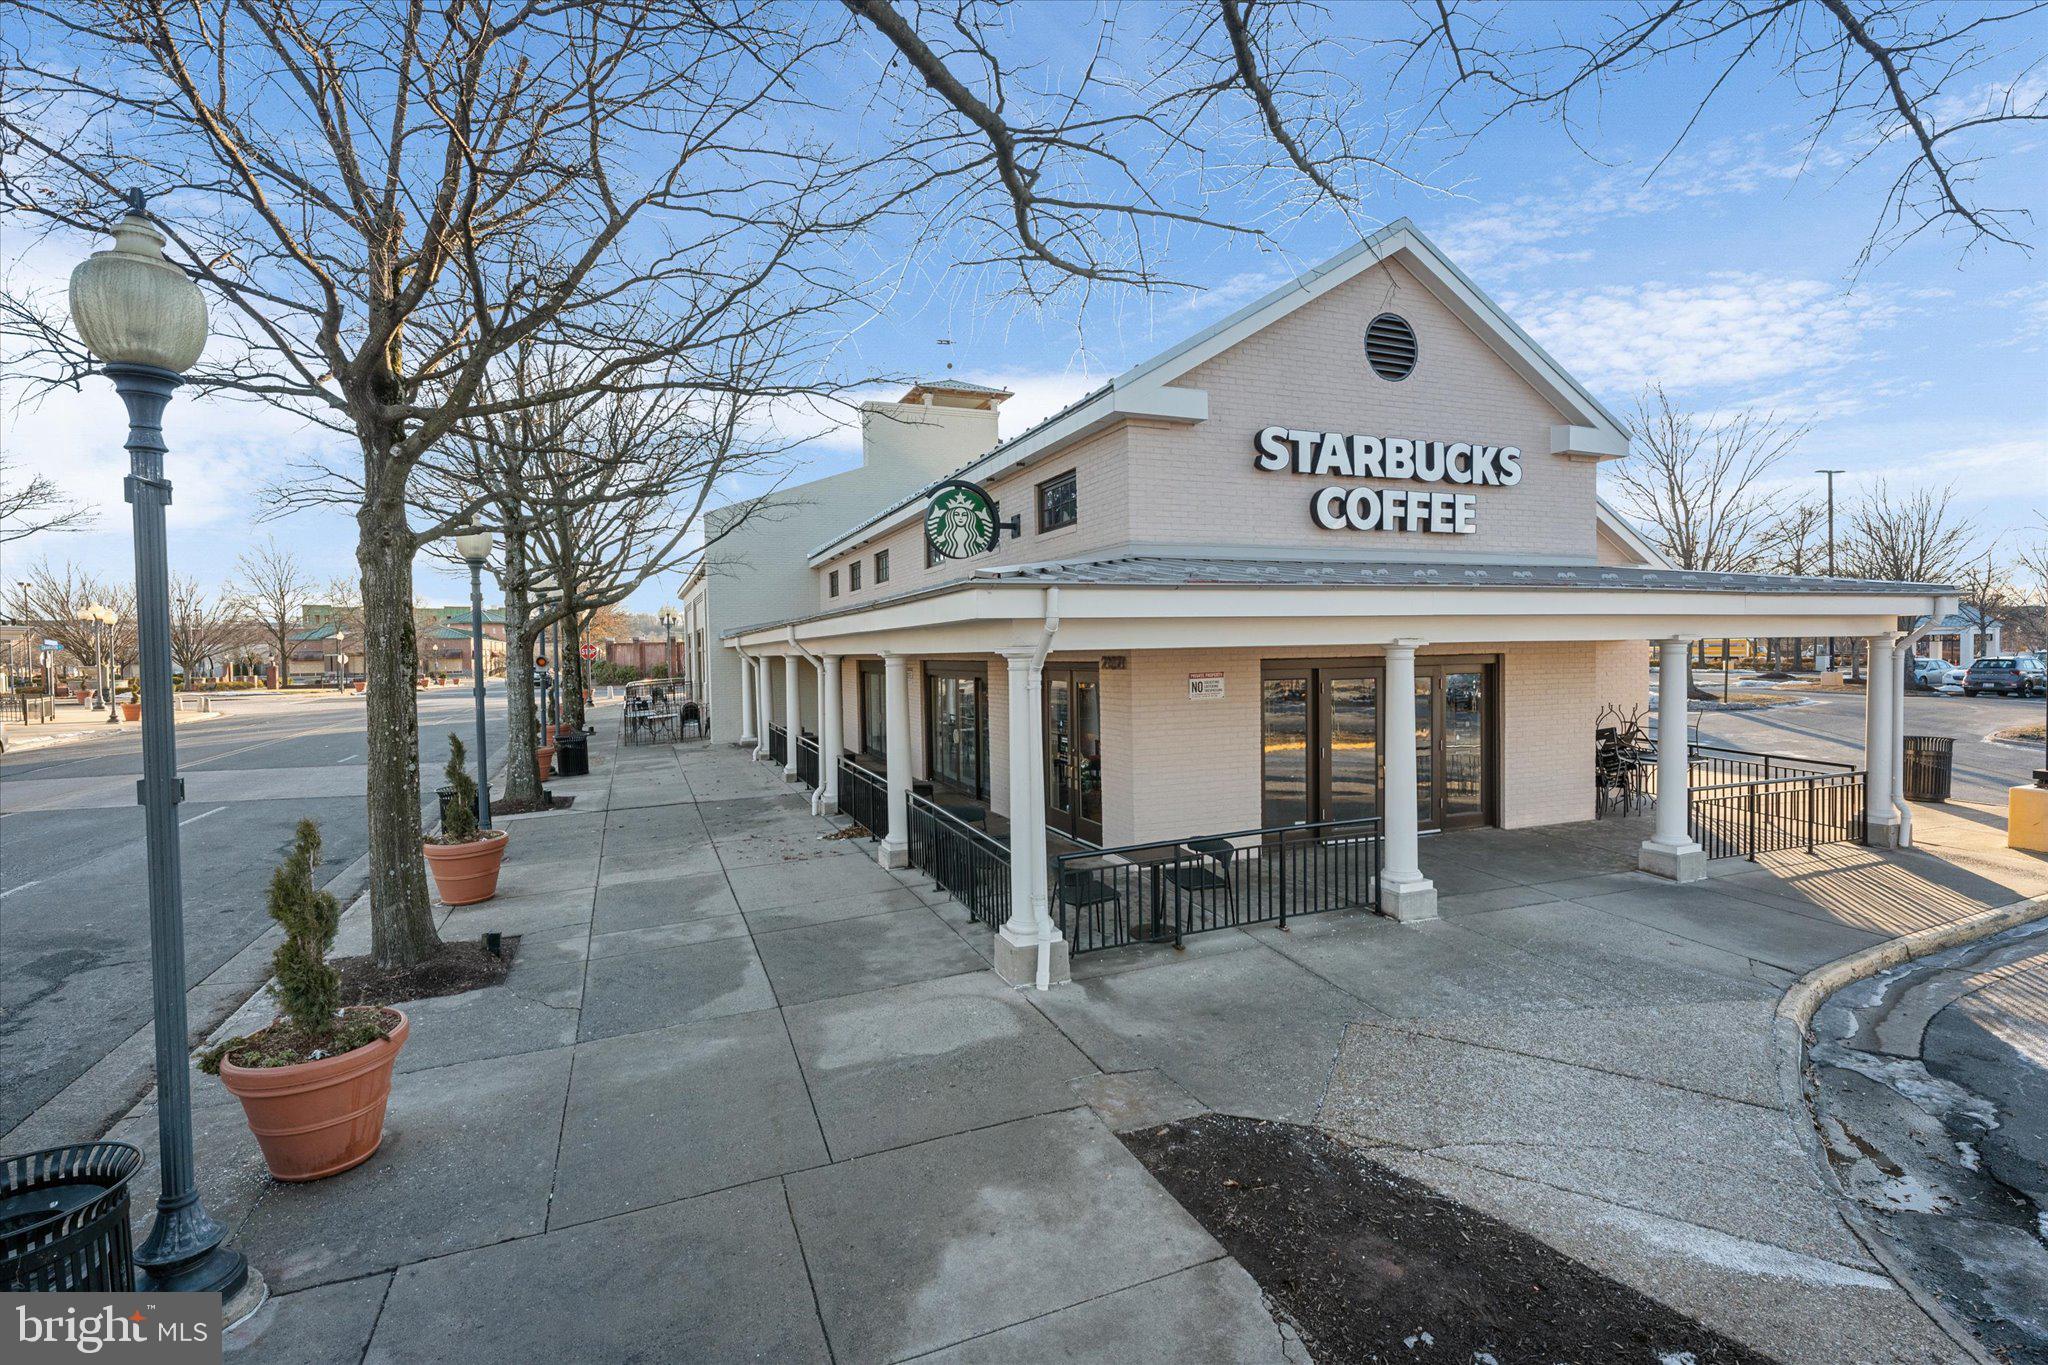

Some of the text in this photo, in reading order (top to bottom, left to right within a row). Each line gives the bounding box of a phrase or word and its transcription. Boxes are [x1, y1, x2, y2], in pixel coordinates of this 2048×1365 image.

[1256, 426, 1522, 486] STARBUCKS
[1312, 486, 1477, 534] COFFEE
[1191, 681, 1203, 693] NO
